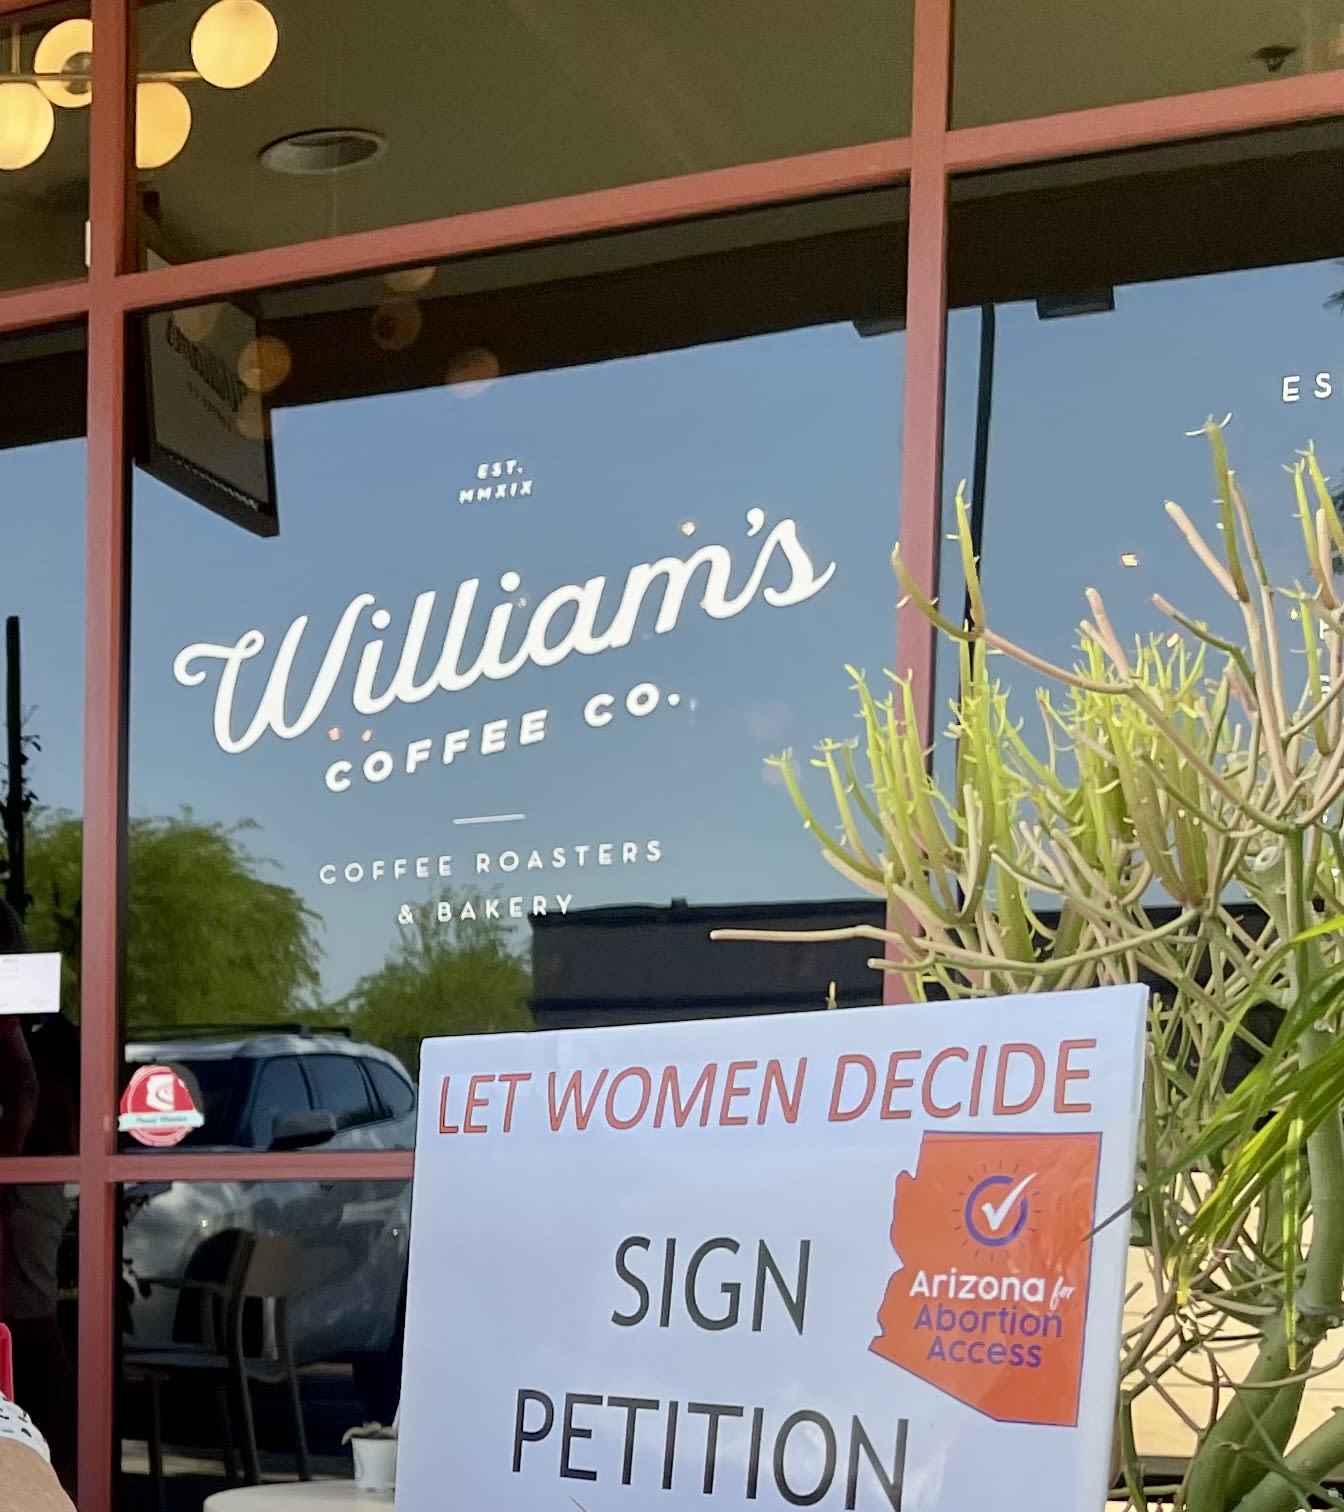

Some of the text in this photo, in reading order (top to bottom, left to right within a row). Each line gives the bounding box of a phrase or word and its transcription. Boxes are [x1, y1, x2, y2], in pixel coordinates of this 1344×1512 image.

[477, 459, 523, 480] EST.
[458, 480, 533, 504] MMXIX
[173, 507, 837, 755] William's
[325, 683, 680, 793] COFFEE CO.
[319, 839, 663, 885] COFFEE ROASTERS
[398, 893, 574, 925] & BAKERY
[438, 1038, 1097, 1136] LET WOMEN DECIDE
[611, 1236, 811, 1335] SIGN
[909, 1267, 1077, 1310] Arizona for
[914, 1303, 1063, 1338] Abortion
[926, 1335, 1042, 1368] Access
